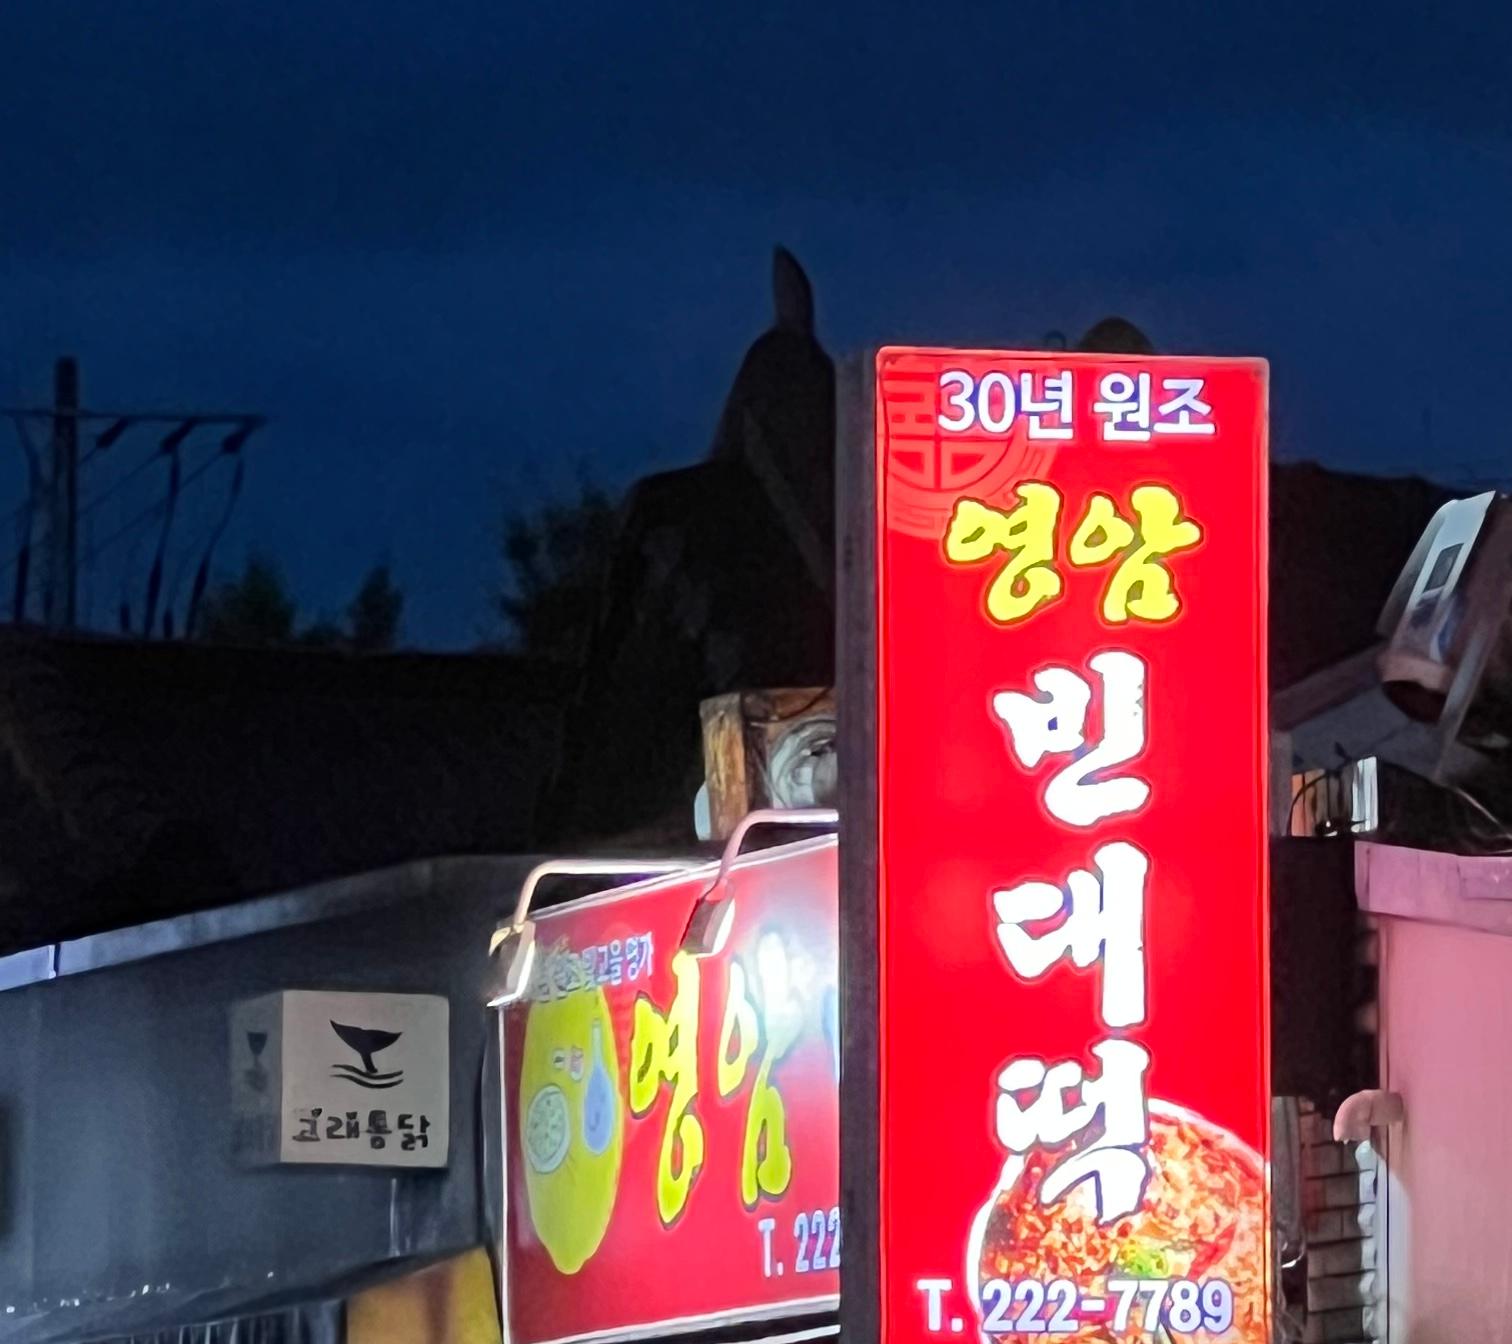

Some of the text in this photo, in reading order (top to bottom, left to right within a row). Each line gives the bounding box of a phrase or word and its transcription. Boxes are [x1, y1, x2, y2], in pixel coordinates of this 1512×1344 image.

[938, 370, 1216, 442] 30년 원조
[944, 481, 1201, 623] 영암
[992, 649, 1152, 1224] 빈대떡
[629, 930, 815, 1226] 영암
[292, 1108, 430, 1151] 고래통닭
[757, 1217, 784, 1277] T.
[916, 1278, 1234, 1334] T. 222-7789
